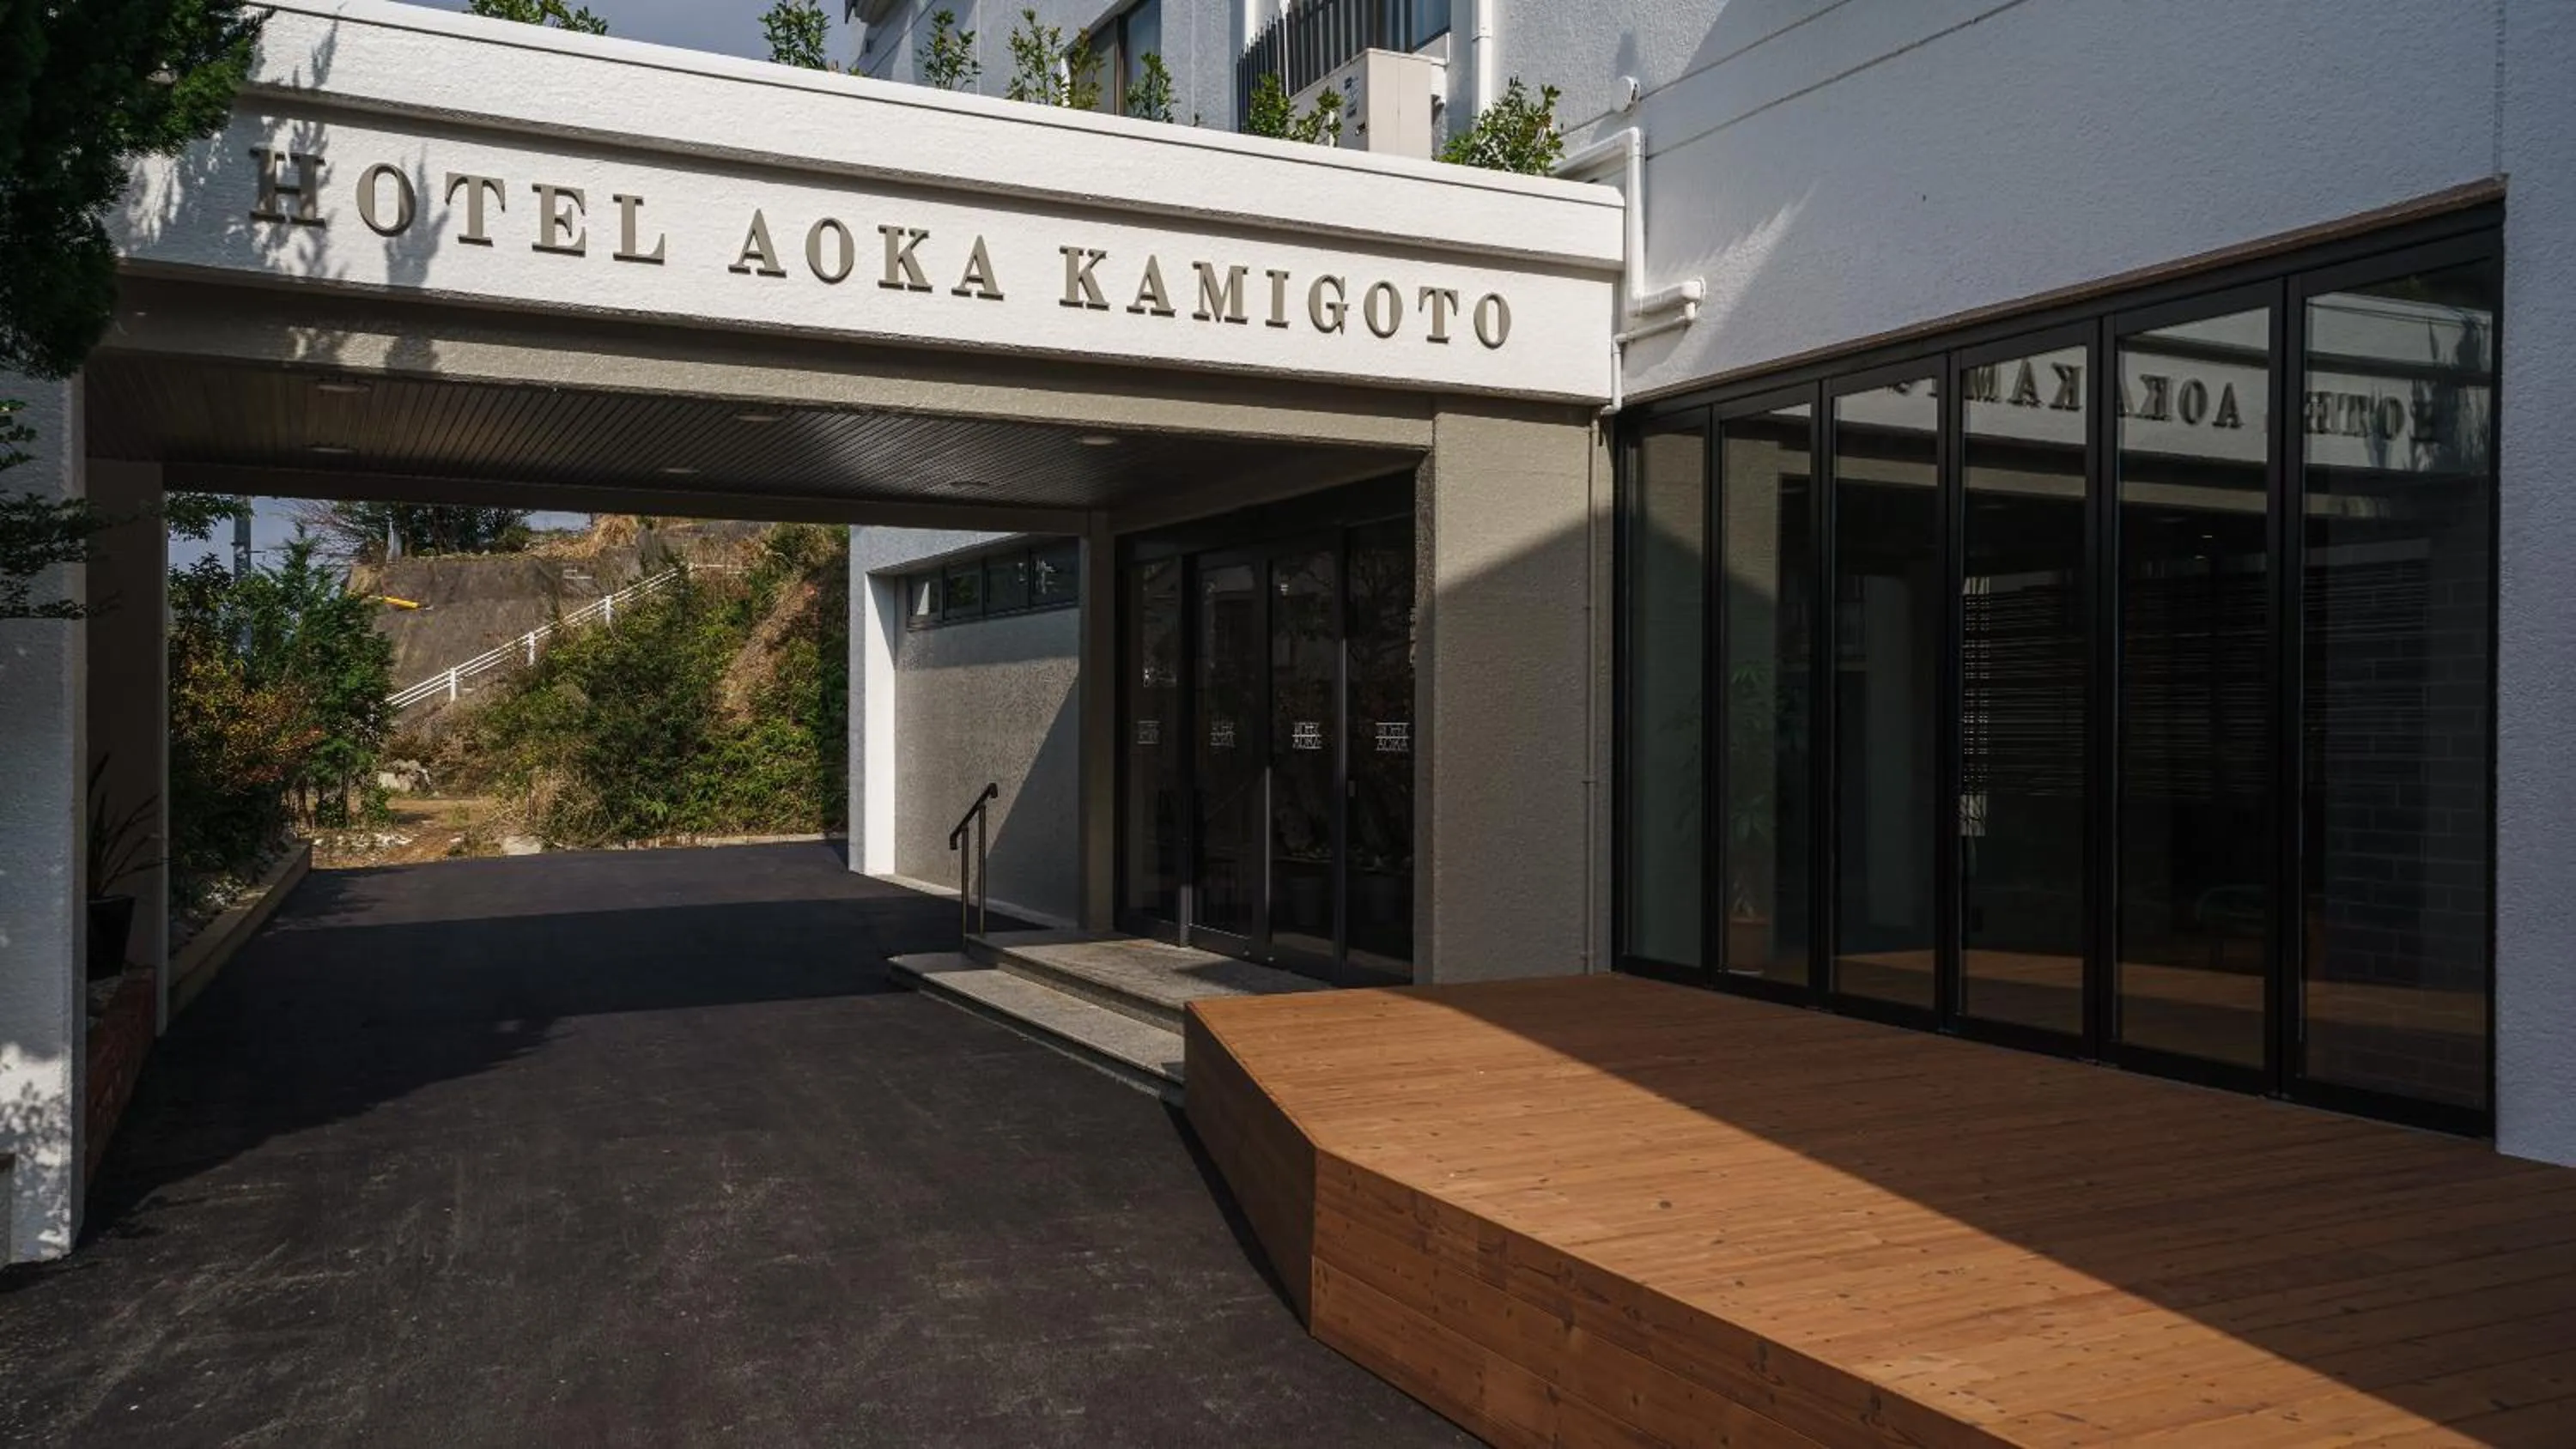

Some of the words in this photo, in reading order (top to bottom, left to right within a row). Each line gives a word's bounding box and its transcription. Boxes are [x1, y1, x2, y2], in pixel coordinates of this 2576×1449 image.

[249, 143, 665, 265] HOTEL
[728, 208, 1005, 301] AOKA
[1059, 246, 1512, 349] KAMIGOTO
